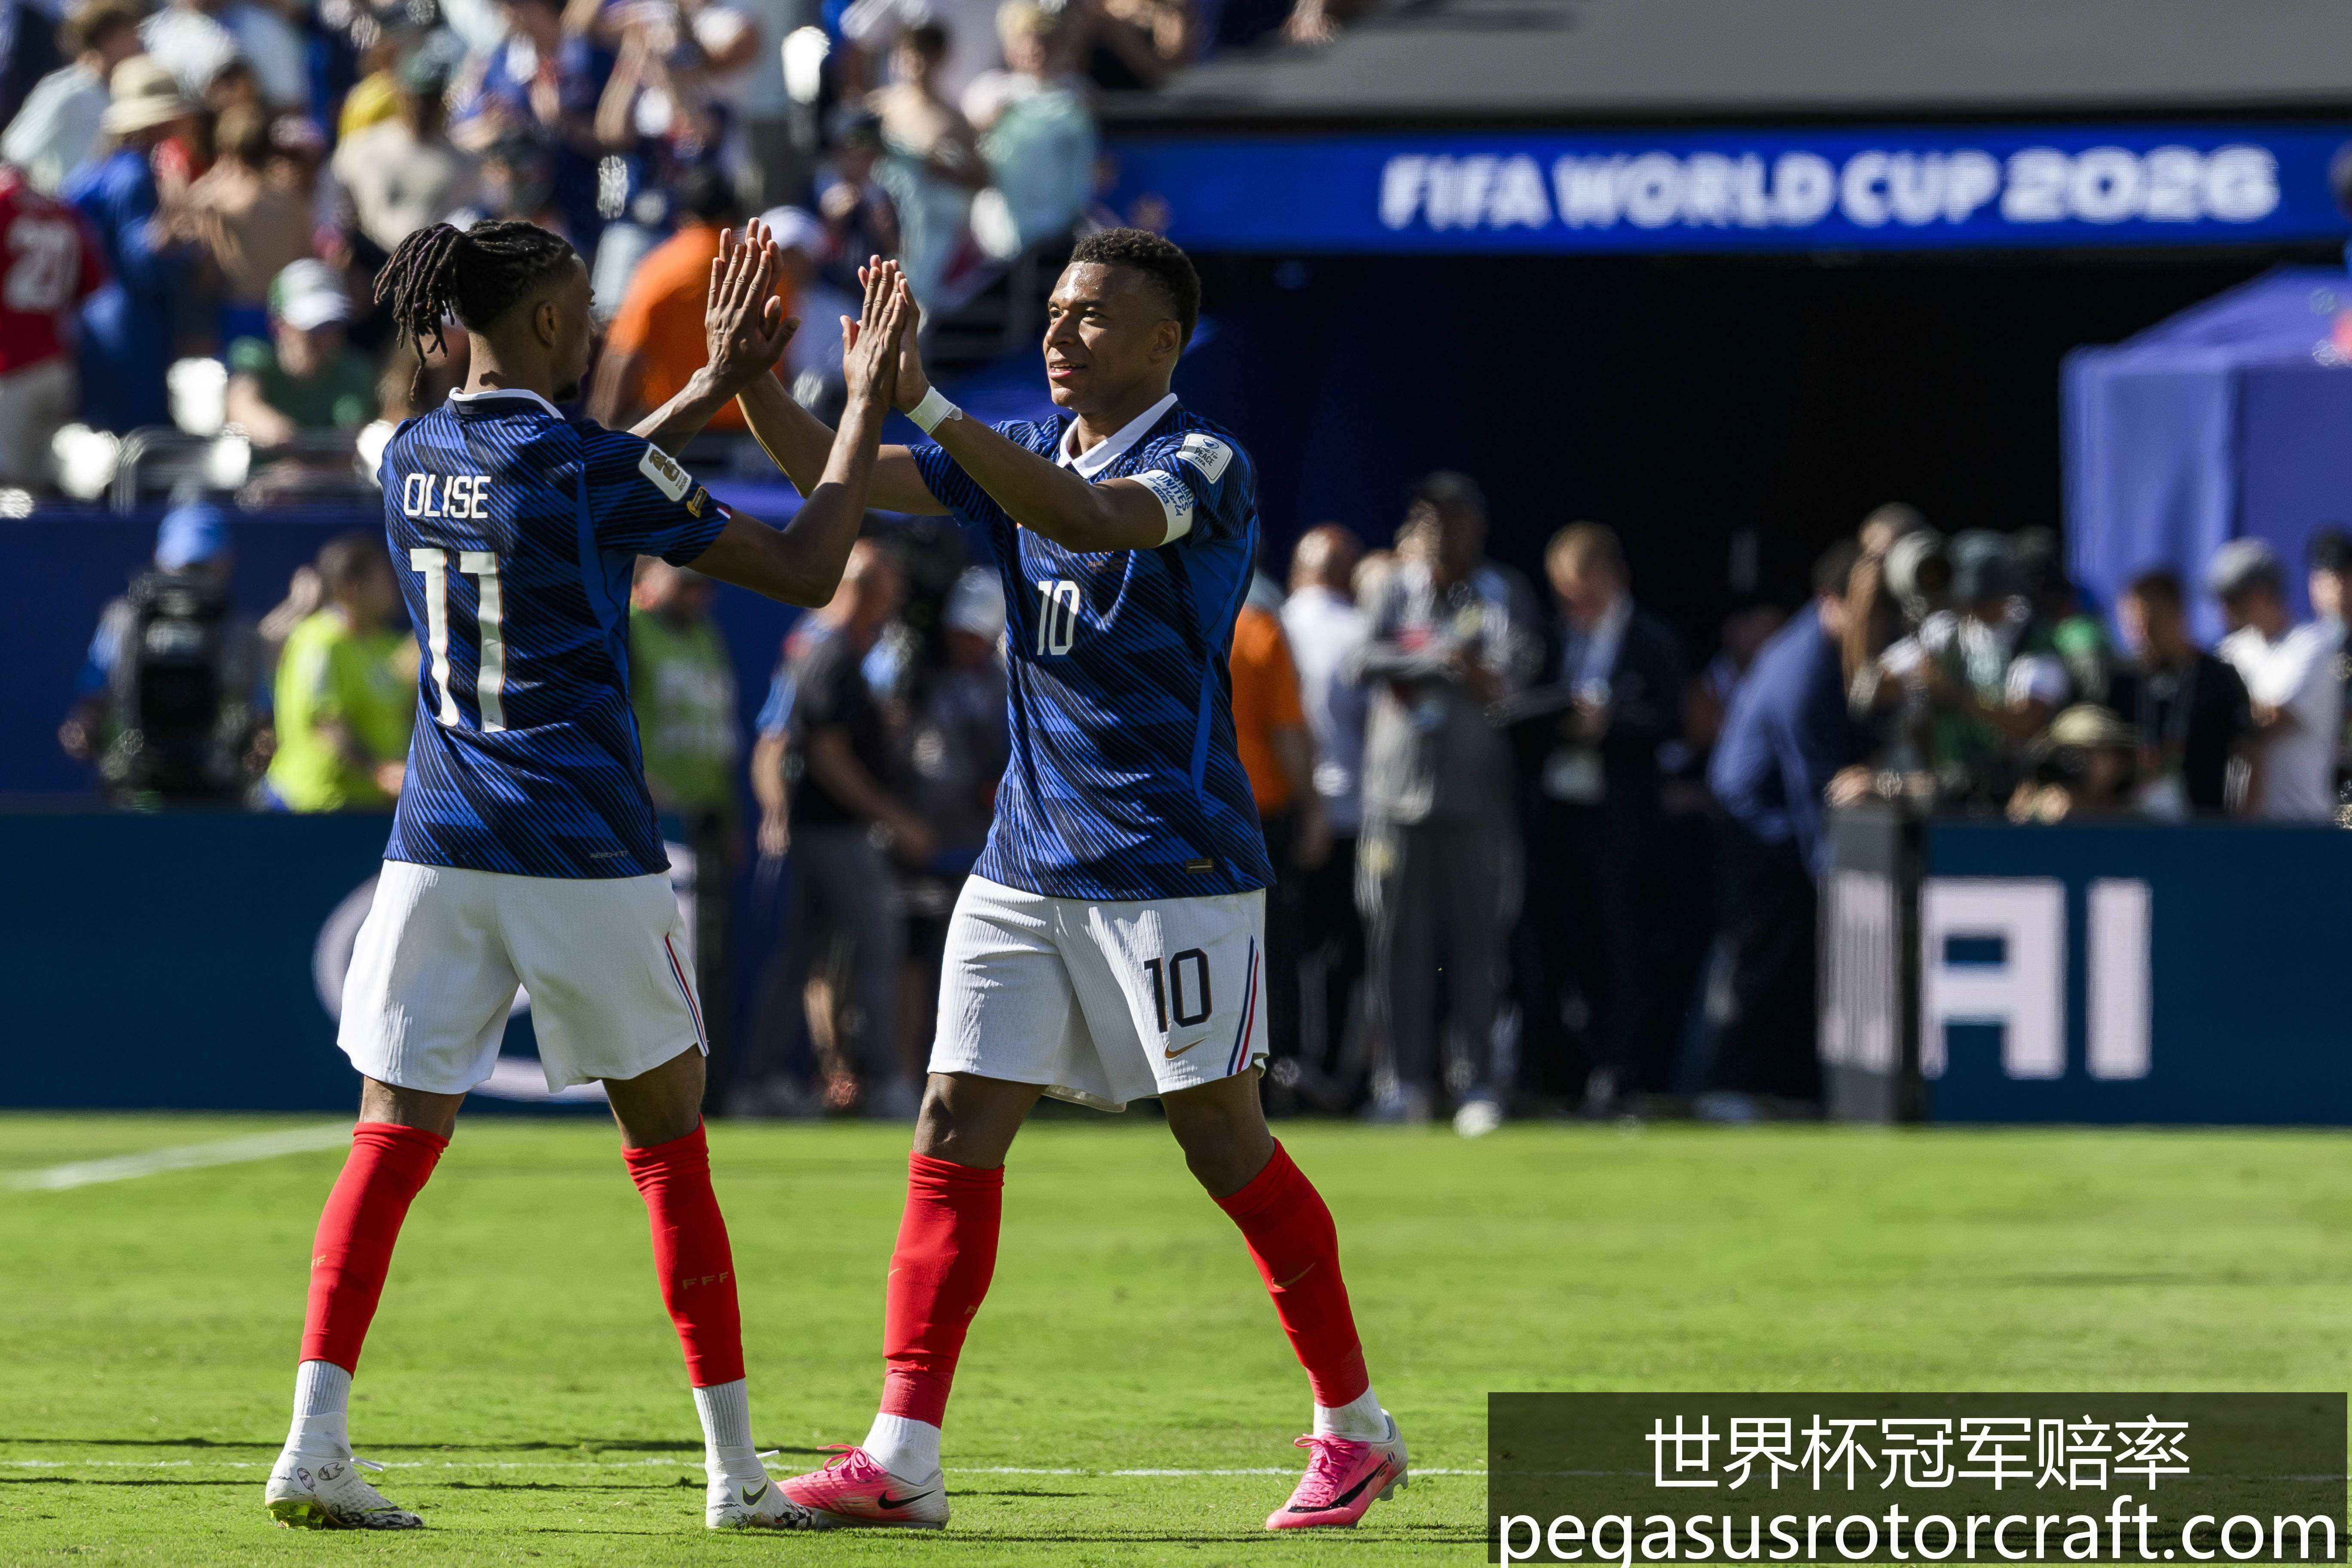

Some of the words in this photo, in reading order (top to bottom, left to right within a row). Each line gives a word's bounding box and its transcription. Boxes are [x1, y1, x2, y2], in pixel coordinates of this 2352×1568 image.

[1381, 154, 1549, 229] FIFA
[1553, 152, 1836, 228] WORLD
[1841, 150, 1999, 225] CUP
[2001, 145, 2279, 223] 2026
[1194, 447, 1215, 467] PEACE
[1194, 456, 1206, 468] FIFA
[403, 473, 491, 519] OLISE
[1156, 474, 1189, 511] UNITES
[410, 548, 507, 732] 11
[1036, 581, 1080, 655] 10
[1144, 947, 1213, 1033] 10
[682, 1271, 729, 1290] FFF
